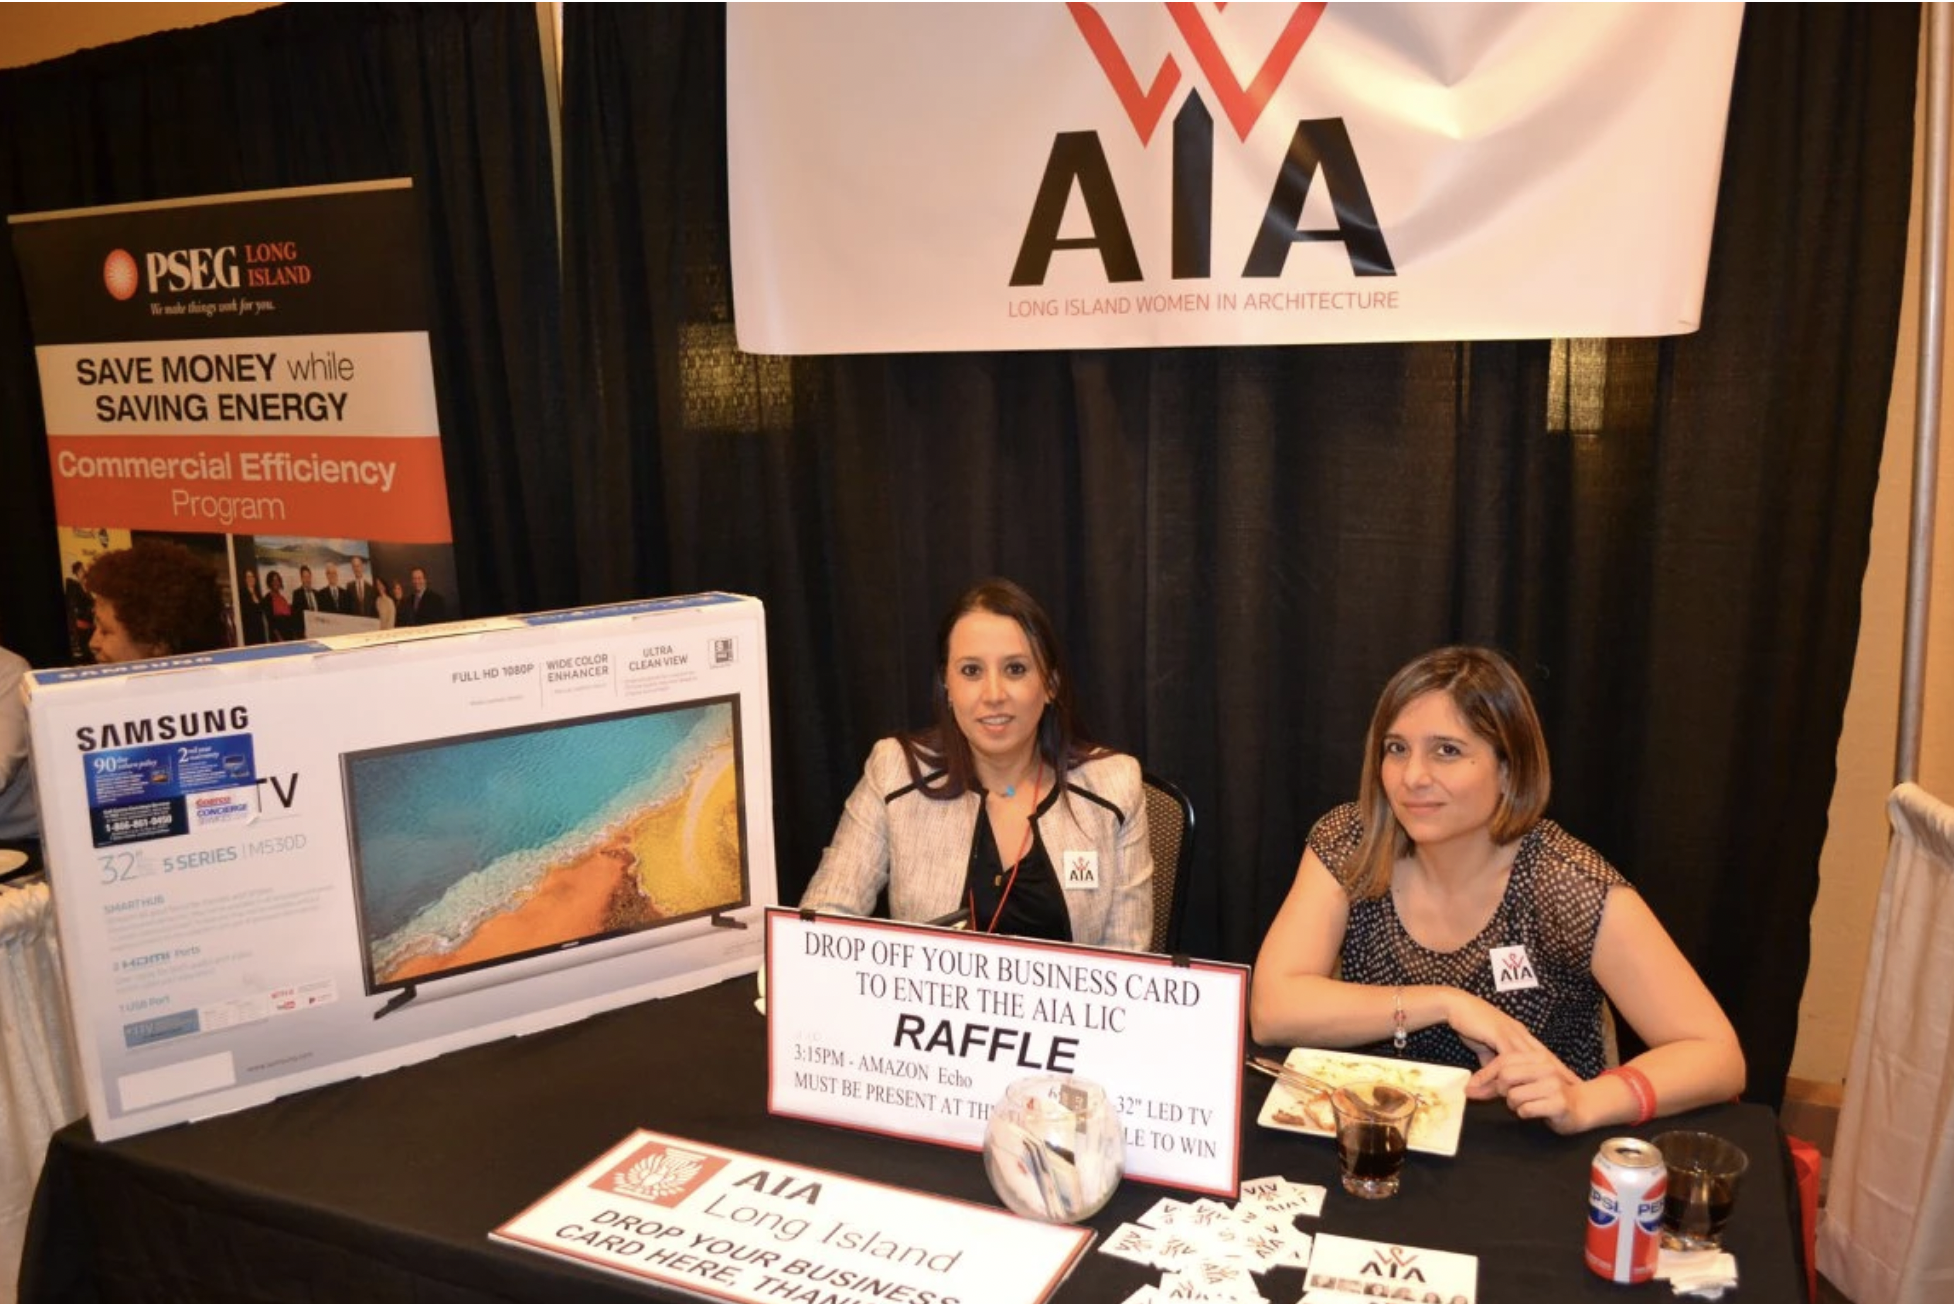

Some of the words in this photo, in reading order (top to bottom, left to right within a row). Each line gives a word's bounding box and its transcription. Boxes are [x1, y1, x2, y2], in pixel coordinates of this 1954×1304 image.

[1009, 86, 1397, 287] AIA
[244, 241, 297, 264] LONG
[146, 246, 240, 293] PSEG
[247, 265, 311, 287] ISLAND
[164, 301, 186, 314] make
[188, 300, 217, 317] things
[239, 298, 254, 316] for
[1008, 300, 1058, 317] LONG
[1065, 298, 1131, 316] ISLAND
[1136, 295, 1210, 313] WOMEN
[1217, 293, 1236, 311] IN
[1244, 290, 1399, 311] ARCHITECTURE
[76, 357, 154, 386] SAVE
[162, 353, 278, 382] MONEY
[286, 351, 355, 381] while
[96, 393, 208, 422] SAVING
[219, 392, 349, 421] ENERGY
[58, 450, 231, 480] Commercial
[240, 452, 397, 492] Efficiency
[171, 489, 286, 525] Program
[546, 657, 574, 670] WIDE
[574, 653, 609, 668] COLOR
[628, 658, 662, 672] CLEAN
[663, 654, 688, 666] VIEW
[642, 645, 673, 658] ULTRA
[452, 670, 481, 684] FULL
[482, 667, 499, 679] HD
[502, 663, 535, 677] 1080P
[547, 666, 609, 682] ENHANCER
[76, 706, 249, 752] SAMSUNG
[93, 757, 117, 774] 90
[177, 747, 190, 763] 2
[197, 803, 248, 817] CONCIERGE
[163, 858, 174, 873] 5
[176, 846, 238, 871] SERIES
[247, 834, 307, 857] M530D
[1070, 869, 1094, 881] AIA
[804, 930, 867, 962] DROP
[871, 939, 915, 968] OFF
[922, 945, 990, 981] YOUR
[997, 955, 1118, 998] BUSINESS
[1124, 973, 1201, 1008] CARD
[1501, 966, 1533, 982] AIA
[856, 970, 886, 999] TO
[894, 977, 969, 1011] ENTER
[977, 988, 1025, 1019] THE
[1032, 995, 1077, 1027] AIA
[1084, 1003, 1127, 1033] LIC
[893, 1013, 1080, 1074] RAFFLE
[794, 1043, 845, 1068] 3:15PM
[857, 1054, 930, 1082] AMAZON
[938, 1066, 973, 1089] Echo
[794, 1071, 838, 1095] MUST
[841, 1079, 862, 1099] BE
[866, 1082, 937, 1112] PRESENT
[940, 1097, 963, 1116] AT
[967, 1100, 996, 1121] TH
[1116, 1095, 1142, 1117] 32"
[1147, 1100, 1183, 1123] LED
[1186, 1107, 1214, 1127] TV
[1122, 1127, 1145, 1147] LE
[1149, 1130, 1175, 1153] TO
[1179, 1137, 1217, 1159] WIN
[732, 1168, 824, 1206] AIA
[1591, 1189, 1621, 1214] PSI
[591, 1209, 685, 1239] DROP
[688, 1233, 782, 1268] YOUR
[703, 1192, 812, 1242] Long
[821, 1221, 963, 1274] Island
[555, 1223, 645, 1256] CARD
[643, 1248, 743, 1287] HERE,
[1360, 1260, 1426, 1284] AIA
